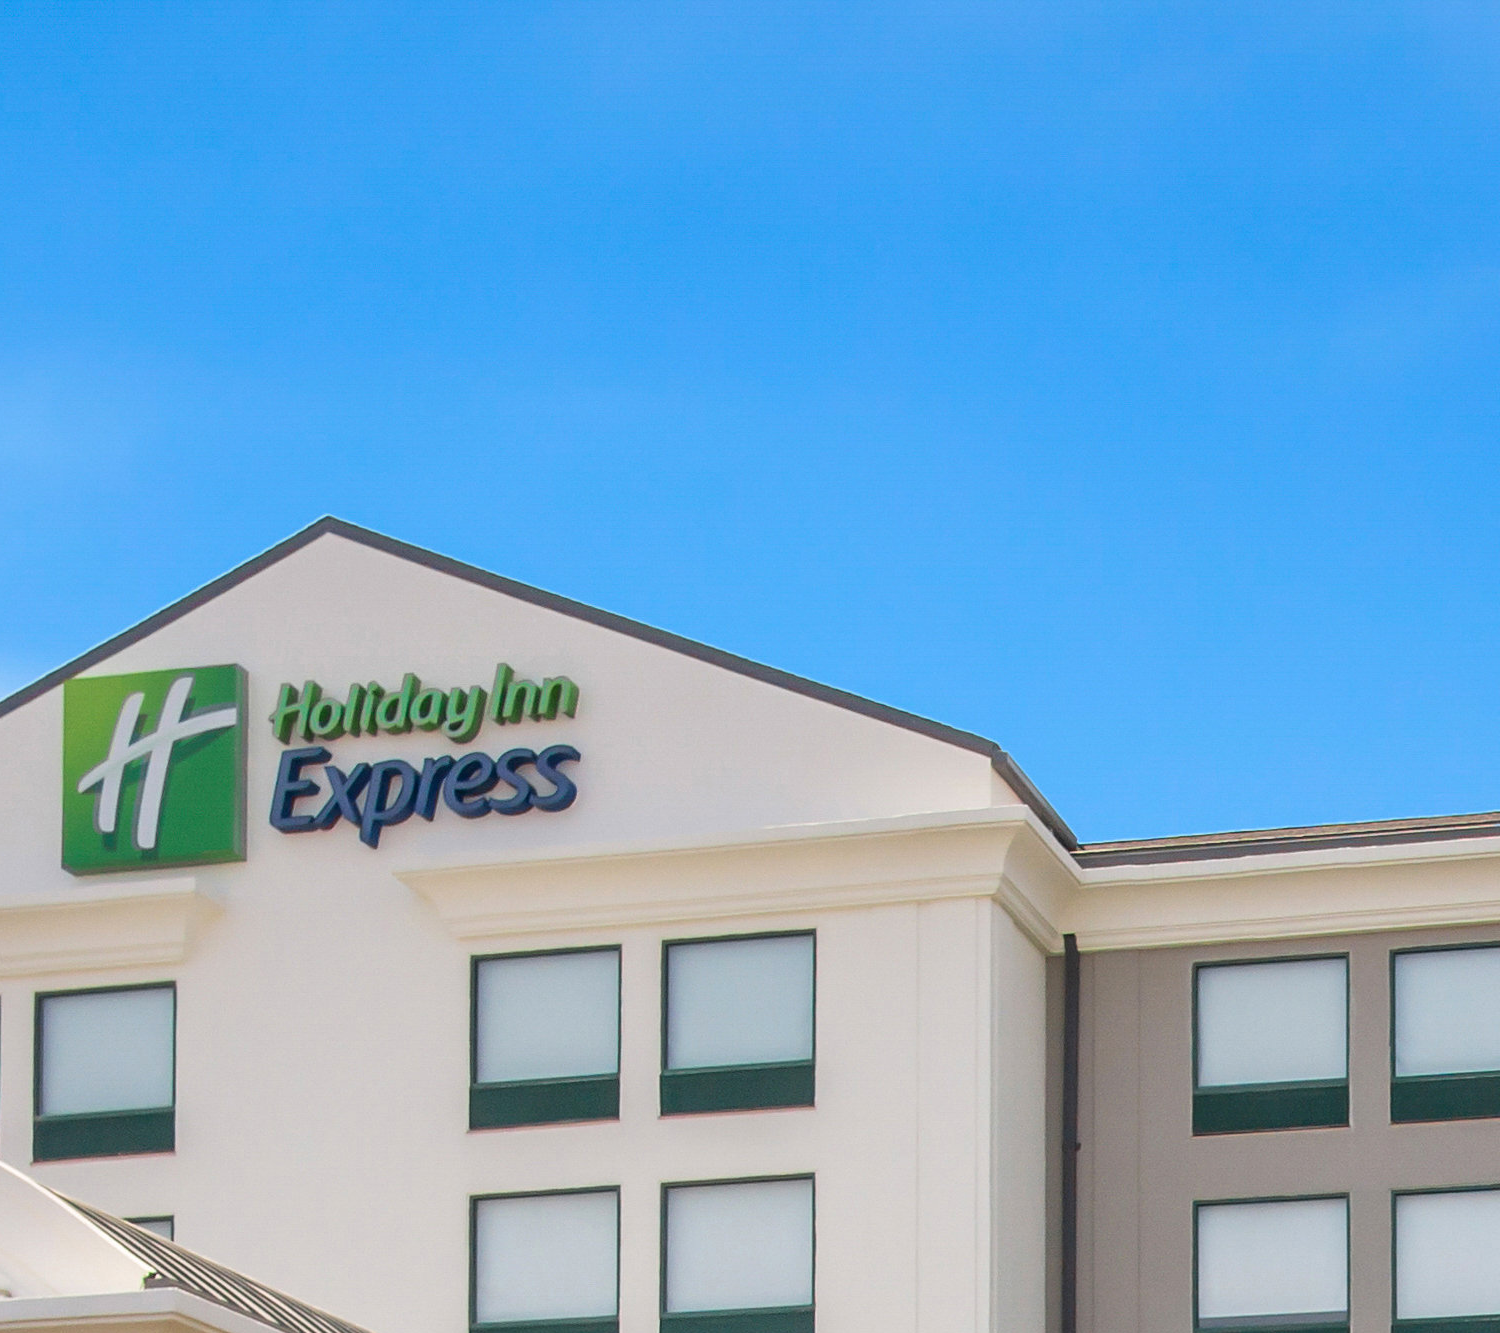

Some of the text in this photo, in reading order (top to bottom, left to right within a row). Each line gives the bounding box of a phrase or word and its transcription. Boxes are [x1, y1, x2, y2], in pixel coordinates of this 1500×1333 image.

[269, 662, 580, 745] Holiday Inn
[269, 744, 581, 849] Express
